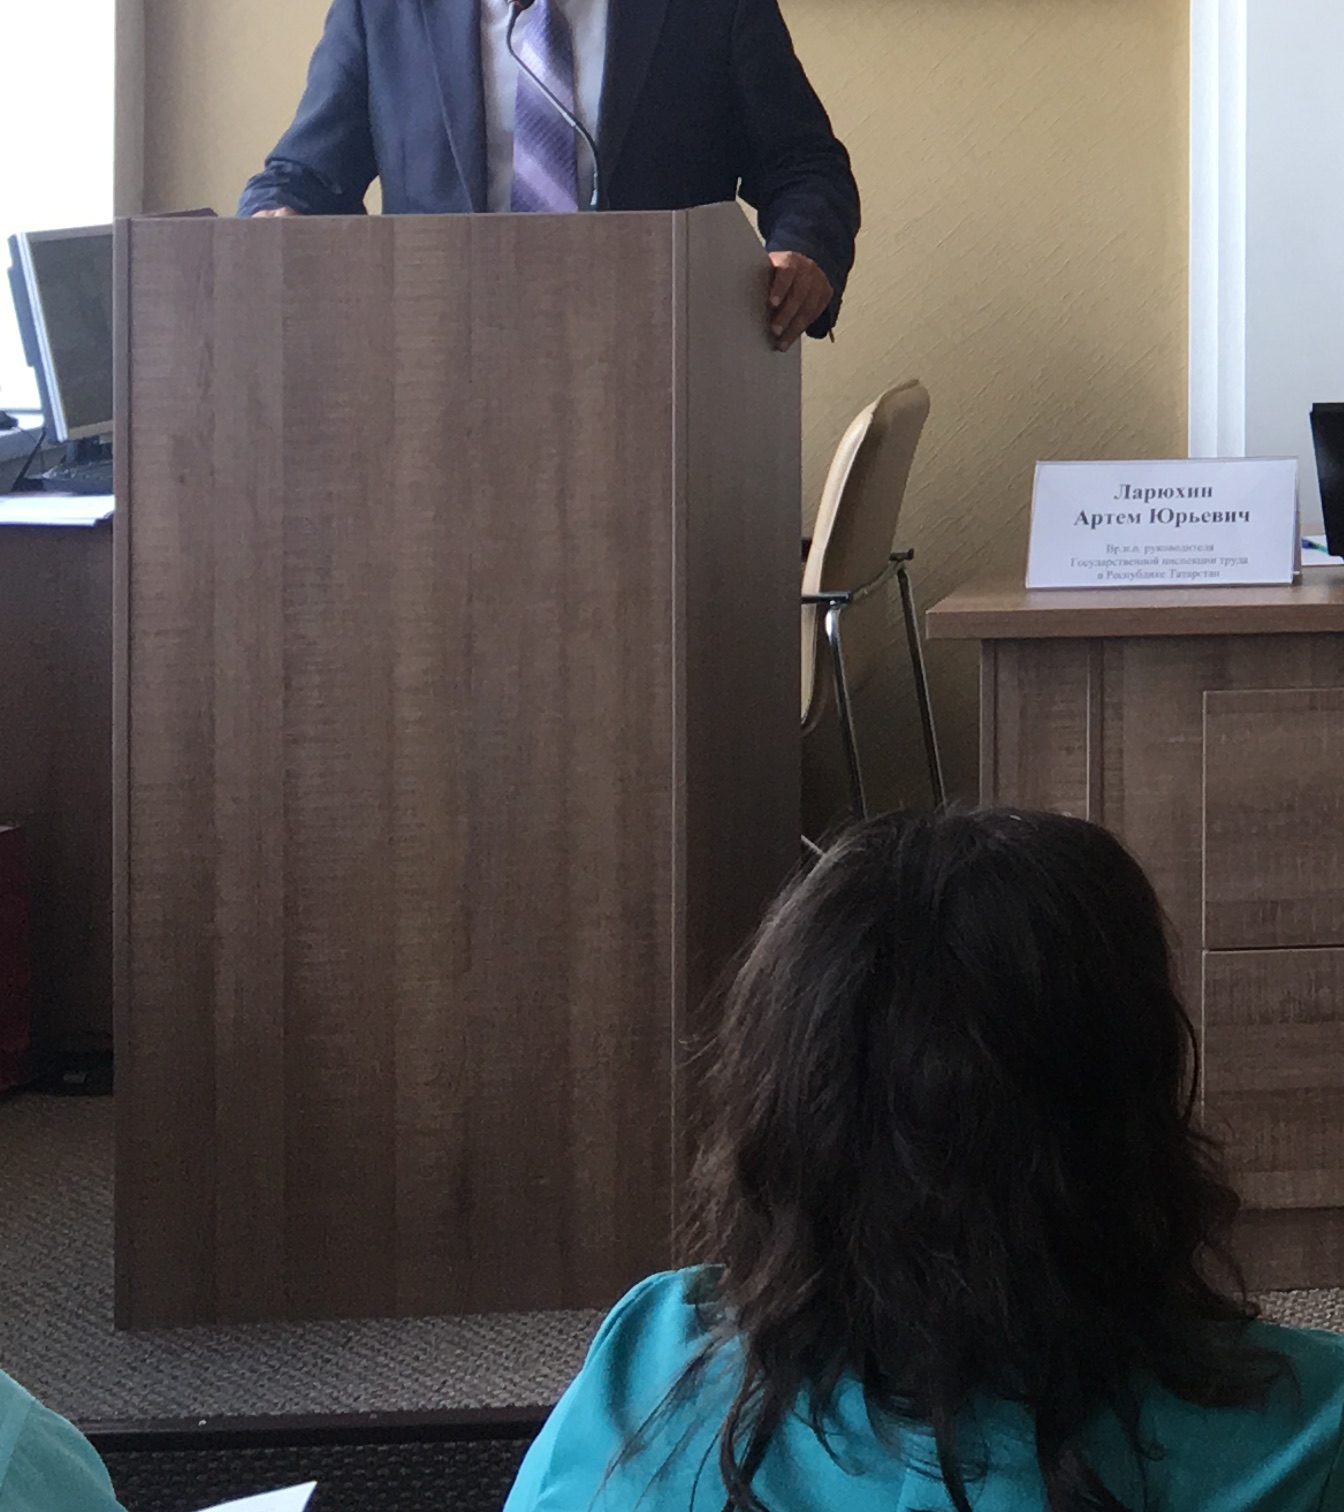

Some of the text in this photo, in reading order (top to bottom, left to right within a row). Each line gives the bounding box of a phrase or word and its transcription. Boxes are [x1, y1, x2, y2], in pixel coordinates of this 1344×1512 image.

[1113, 483, 1213, 503] Ларюхин
[1073, 507, 1251, 529] Артем Юрьевич
[1219, 556, 1249, 567] труда
